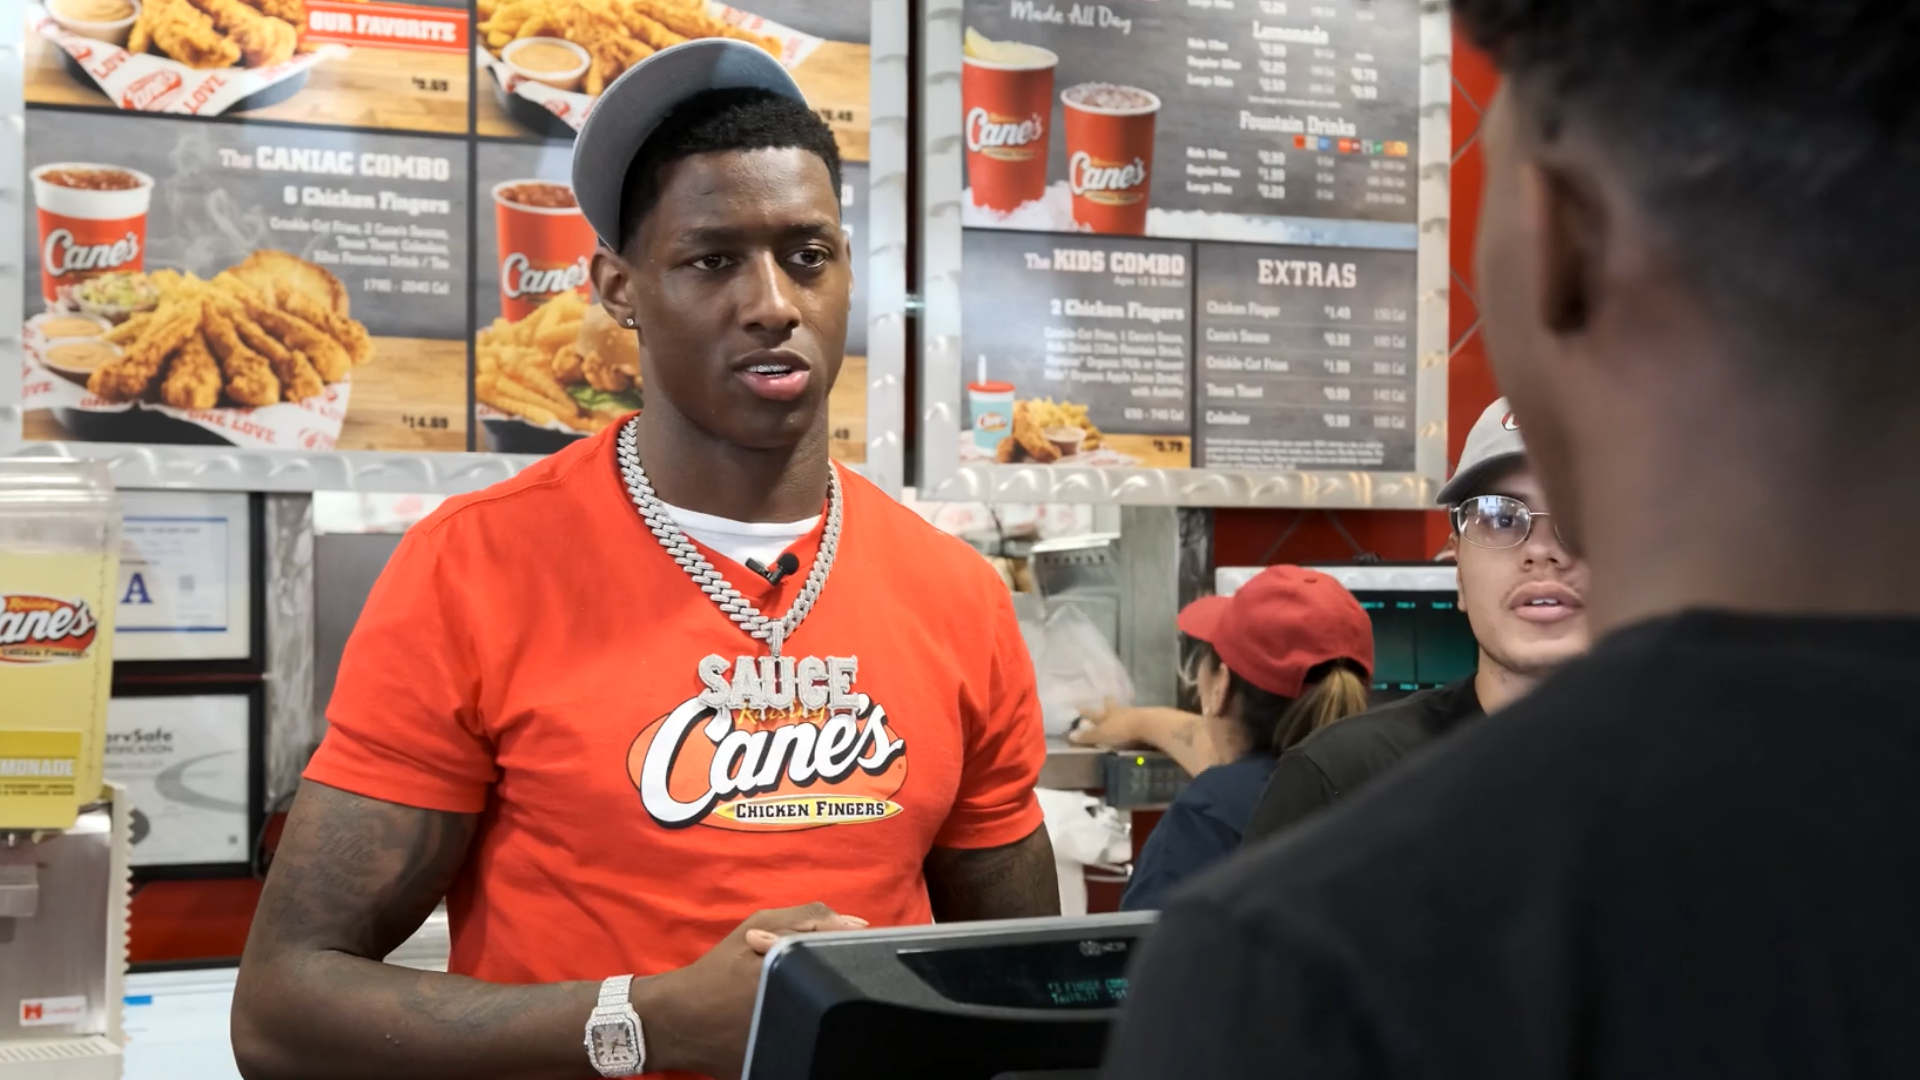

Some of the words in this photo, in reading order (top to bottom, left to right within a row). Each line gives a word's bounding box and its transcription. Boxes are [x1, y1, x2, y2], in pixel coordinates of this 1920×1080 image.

[309, 11, 353, 33] OUR
[356, 14, 457, 42] FAVORITE
[1068, 5, 1095, 27] All
[1098, 5, 1132, 35] Day
[1253, 20, 1329, 45] Lemonade
[966, 106, 1044, 152] Cane's
[1240, 110, 1304, 133] Fountain
[1307, 116, 1357, 137] Drinks
[218, 148, 253, 169] The
[256, 145, 354, 175] CANIAC
[360, 152, 450, 182] COMBO
[1069, 150, 1147, 195] Cane's
[284, 185, 298, 205] 6
[302, 186, 376, 209] Chicken
[379, 191, 450, 216] Fingers
[43, 228, 140, 277] Cane's
[1024, 252, 1051, 270] The
[1053, 248, 1105, 272] KIDS
[1110, 251, 1186, 276] COMBO
[501, 251, 590, 299] Cane's
[1257, 258, 1358, 288] EXTRAS
[1050, 298, 1062, 316] 2
[1064, 299, 1125, 319] Chicken
[1127, 301, 1185, 323] Fingers
[1206, 300, 1246, 315] Chicken
[1248, 301, 1281, 319] Finger
[1206, 328, 1239, 343] Cane's
[1240, 330, 1270, 345] Sauce
[1263, 357, 1289, 373] Fries
[1205, 382, 1236, 398] Texas
[1236, 383, 1263, 398] Toast
[230, 419, 276, 444] LOVE
[1206, 410, 1251, 425] Coleslaw
[120, 572, 154, 605] A
[0, 594, 97, 644] ane's
[698, 654, 859, 718] SAUCE
[0, 758, 75, 777] MONADE
[640, 694, 905, 828] Cane's
[736, 803, 809, 818] CHICKEN
[816, 801, 886, 816] FINGERS
